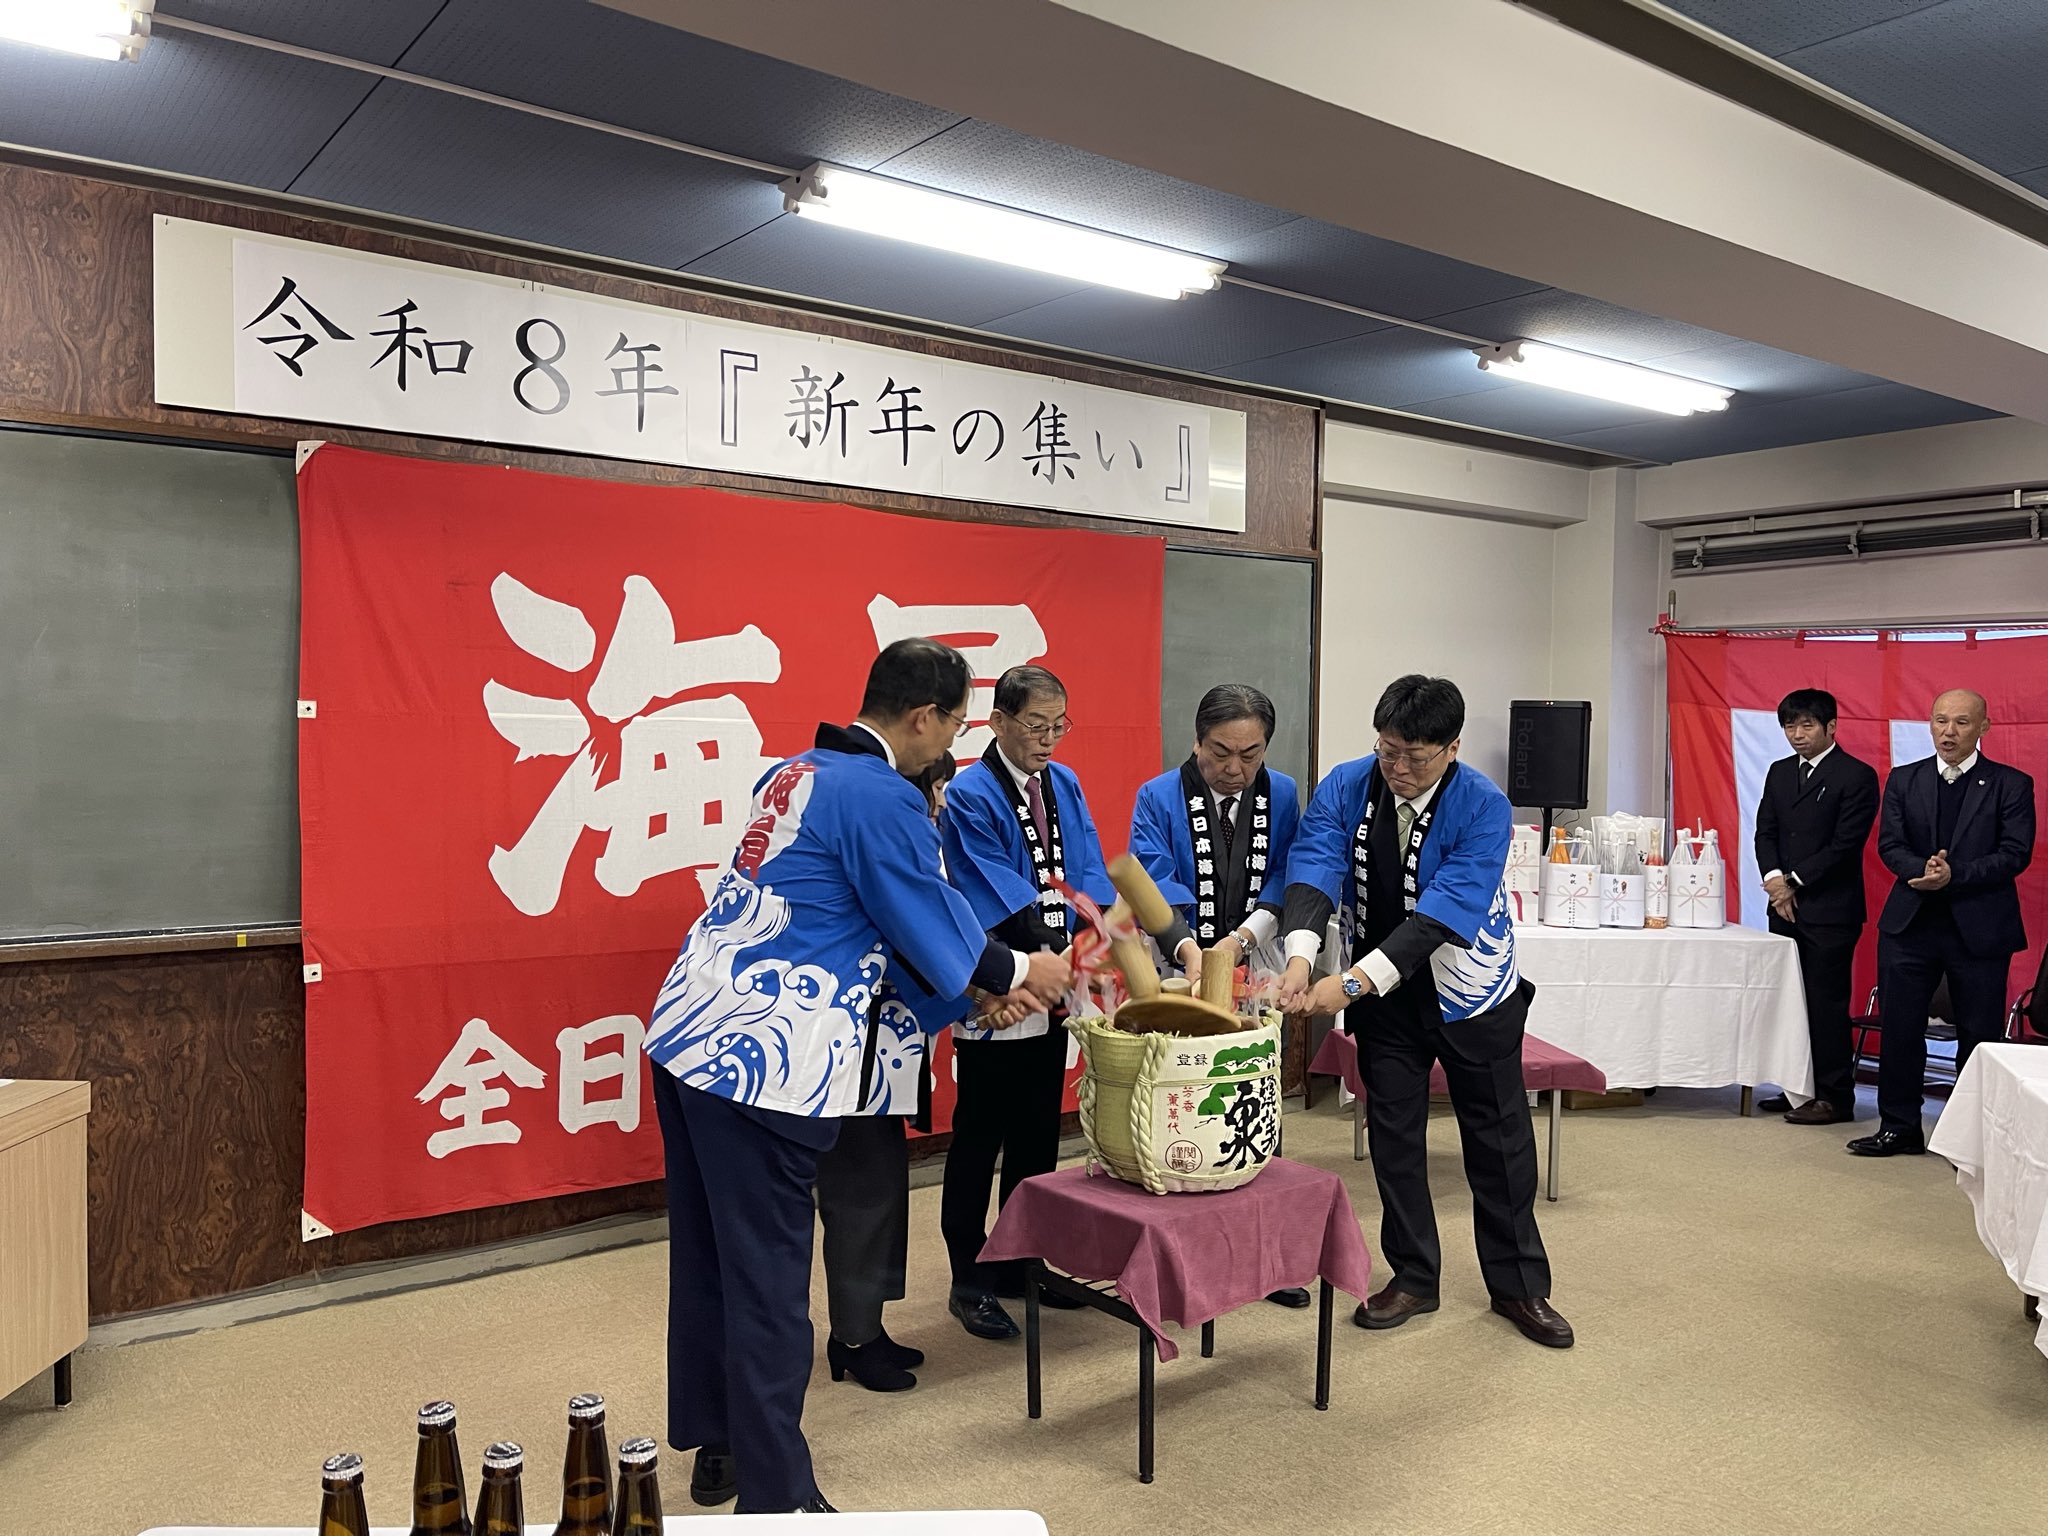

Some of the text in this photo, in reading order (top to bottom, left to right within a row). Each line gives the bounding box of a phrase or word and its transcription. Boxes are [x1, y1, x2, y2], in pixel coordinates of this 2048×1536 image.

[1515, 718, 1533, 789] Roland
[1188, 796, 1215, 938] 全日本海員組合
[1177, 1053, 1208, 1066] 登録
[1182, 1086, 1196, 1113] 芳香
